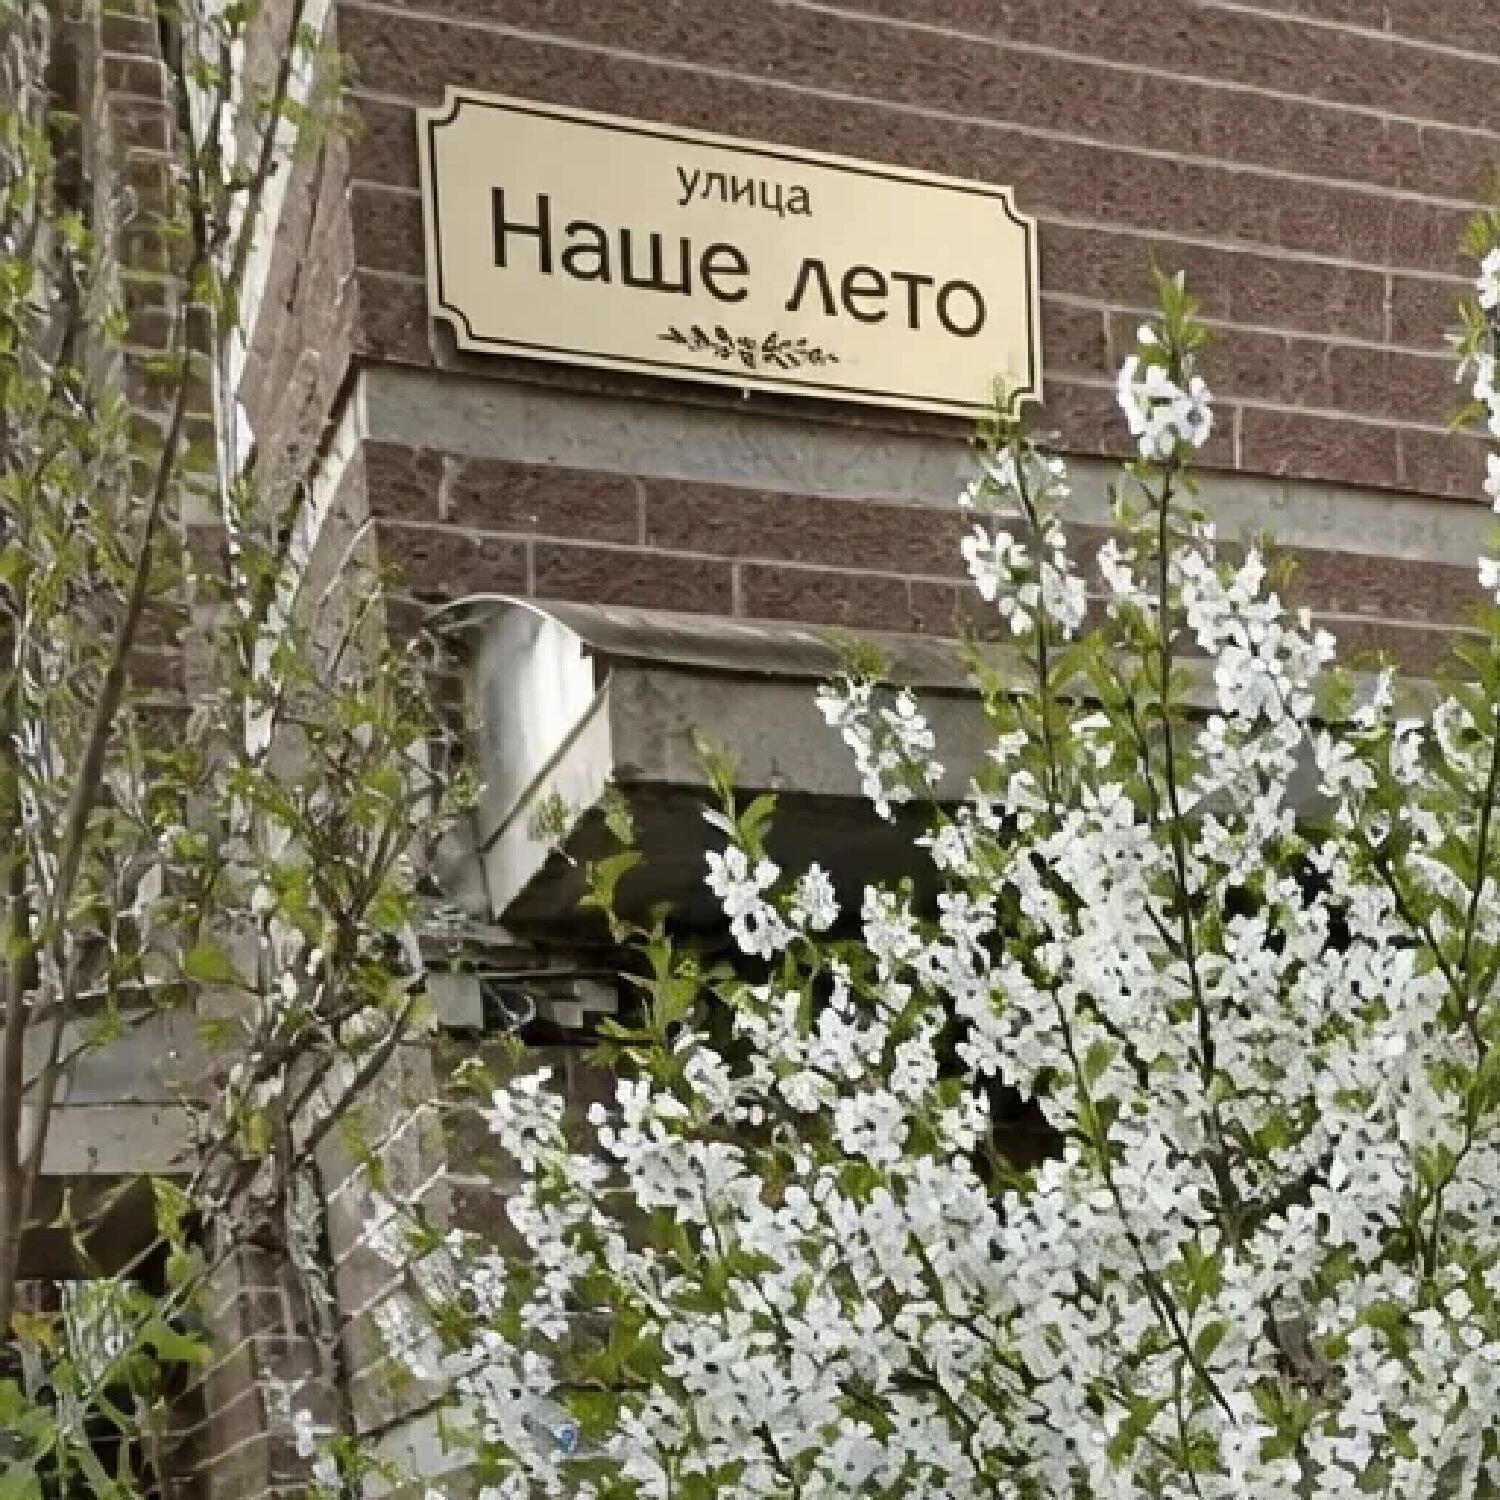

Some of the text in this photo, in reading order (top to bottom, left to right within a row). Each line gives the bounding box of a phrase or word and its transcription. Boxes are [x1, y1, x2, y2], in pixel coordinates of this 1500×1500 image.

[676, 164, 813, 217] улица
[490, 186, 988, 338] Наше лето
